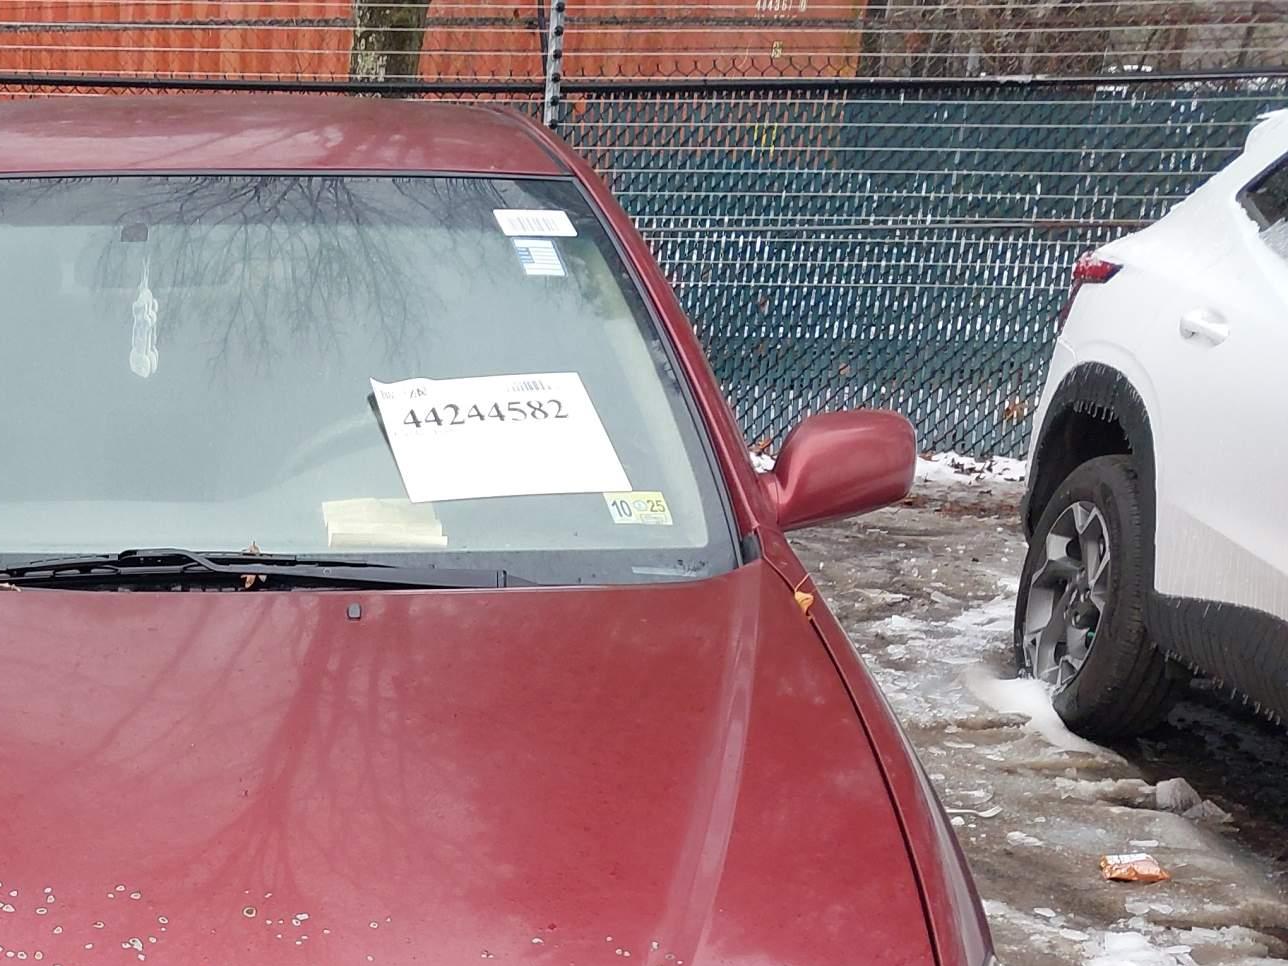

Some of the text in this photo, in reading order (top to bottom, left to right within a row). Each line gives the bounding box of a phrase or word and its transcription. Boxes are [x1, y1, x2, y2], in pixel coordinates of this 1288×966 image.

[403, 399, 569, 428] 44244582
[611, 500, 666, 517] 10 25
